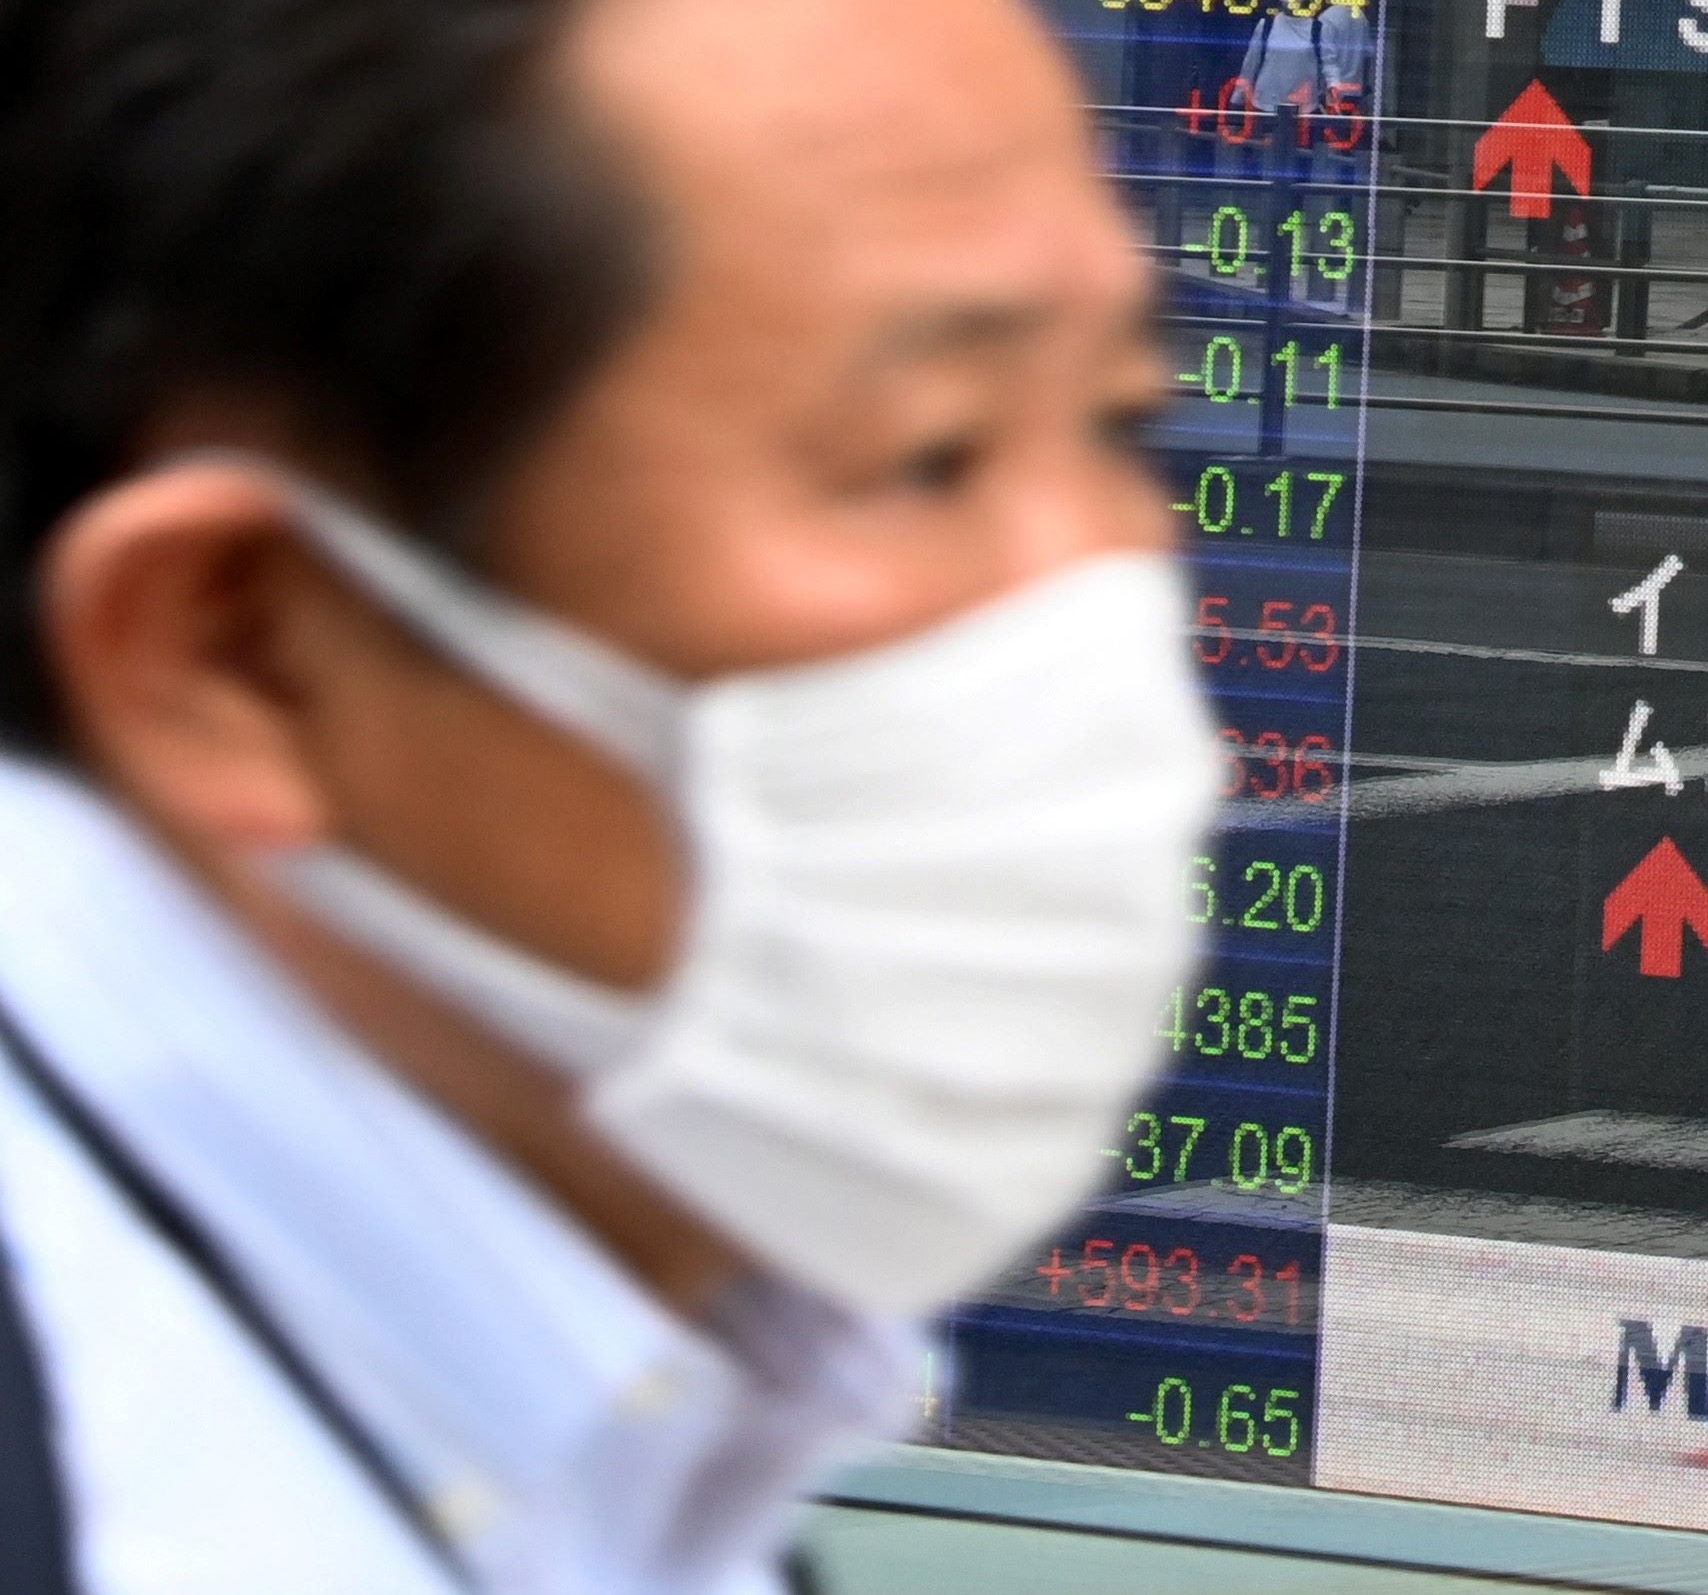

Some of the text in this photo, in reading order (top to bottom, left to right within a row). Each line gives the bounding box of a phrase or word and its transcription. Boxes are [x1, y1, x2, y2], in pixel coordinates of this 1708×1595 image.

[1176, 78, 1364, 150] +0.15
[1182, 206, 1355, 280] -0.13
[1175, 336, 1344, 409] -0.11
[1170, 466, 1348, 539] -0.17
[1036, 1239, 1300, 1326] +593.31
[1126, 1378, 1299, 1457] -0.65
